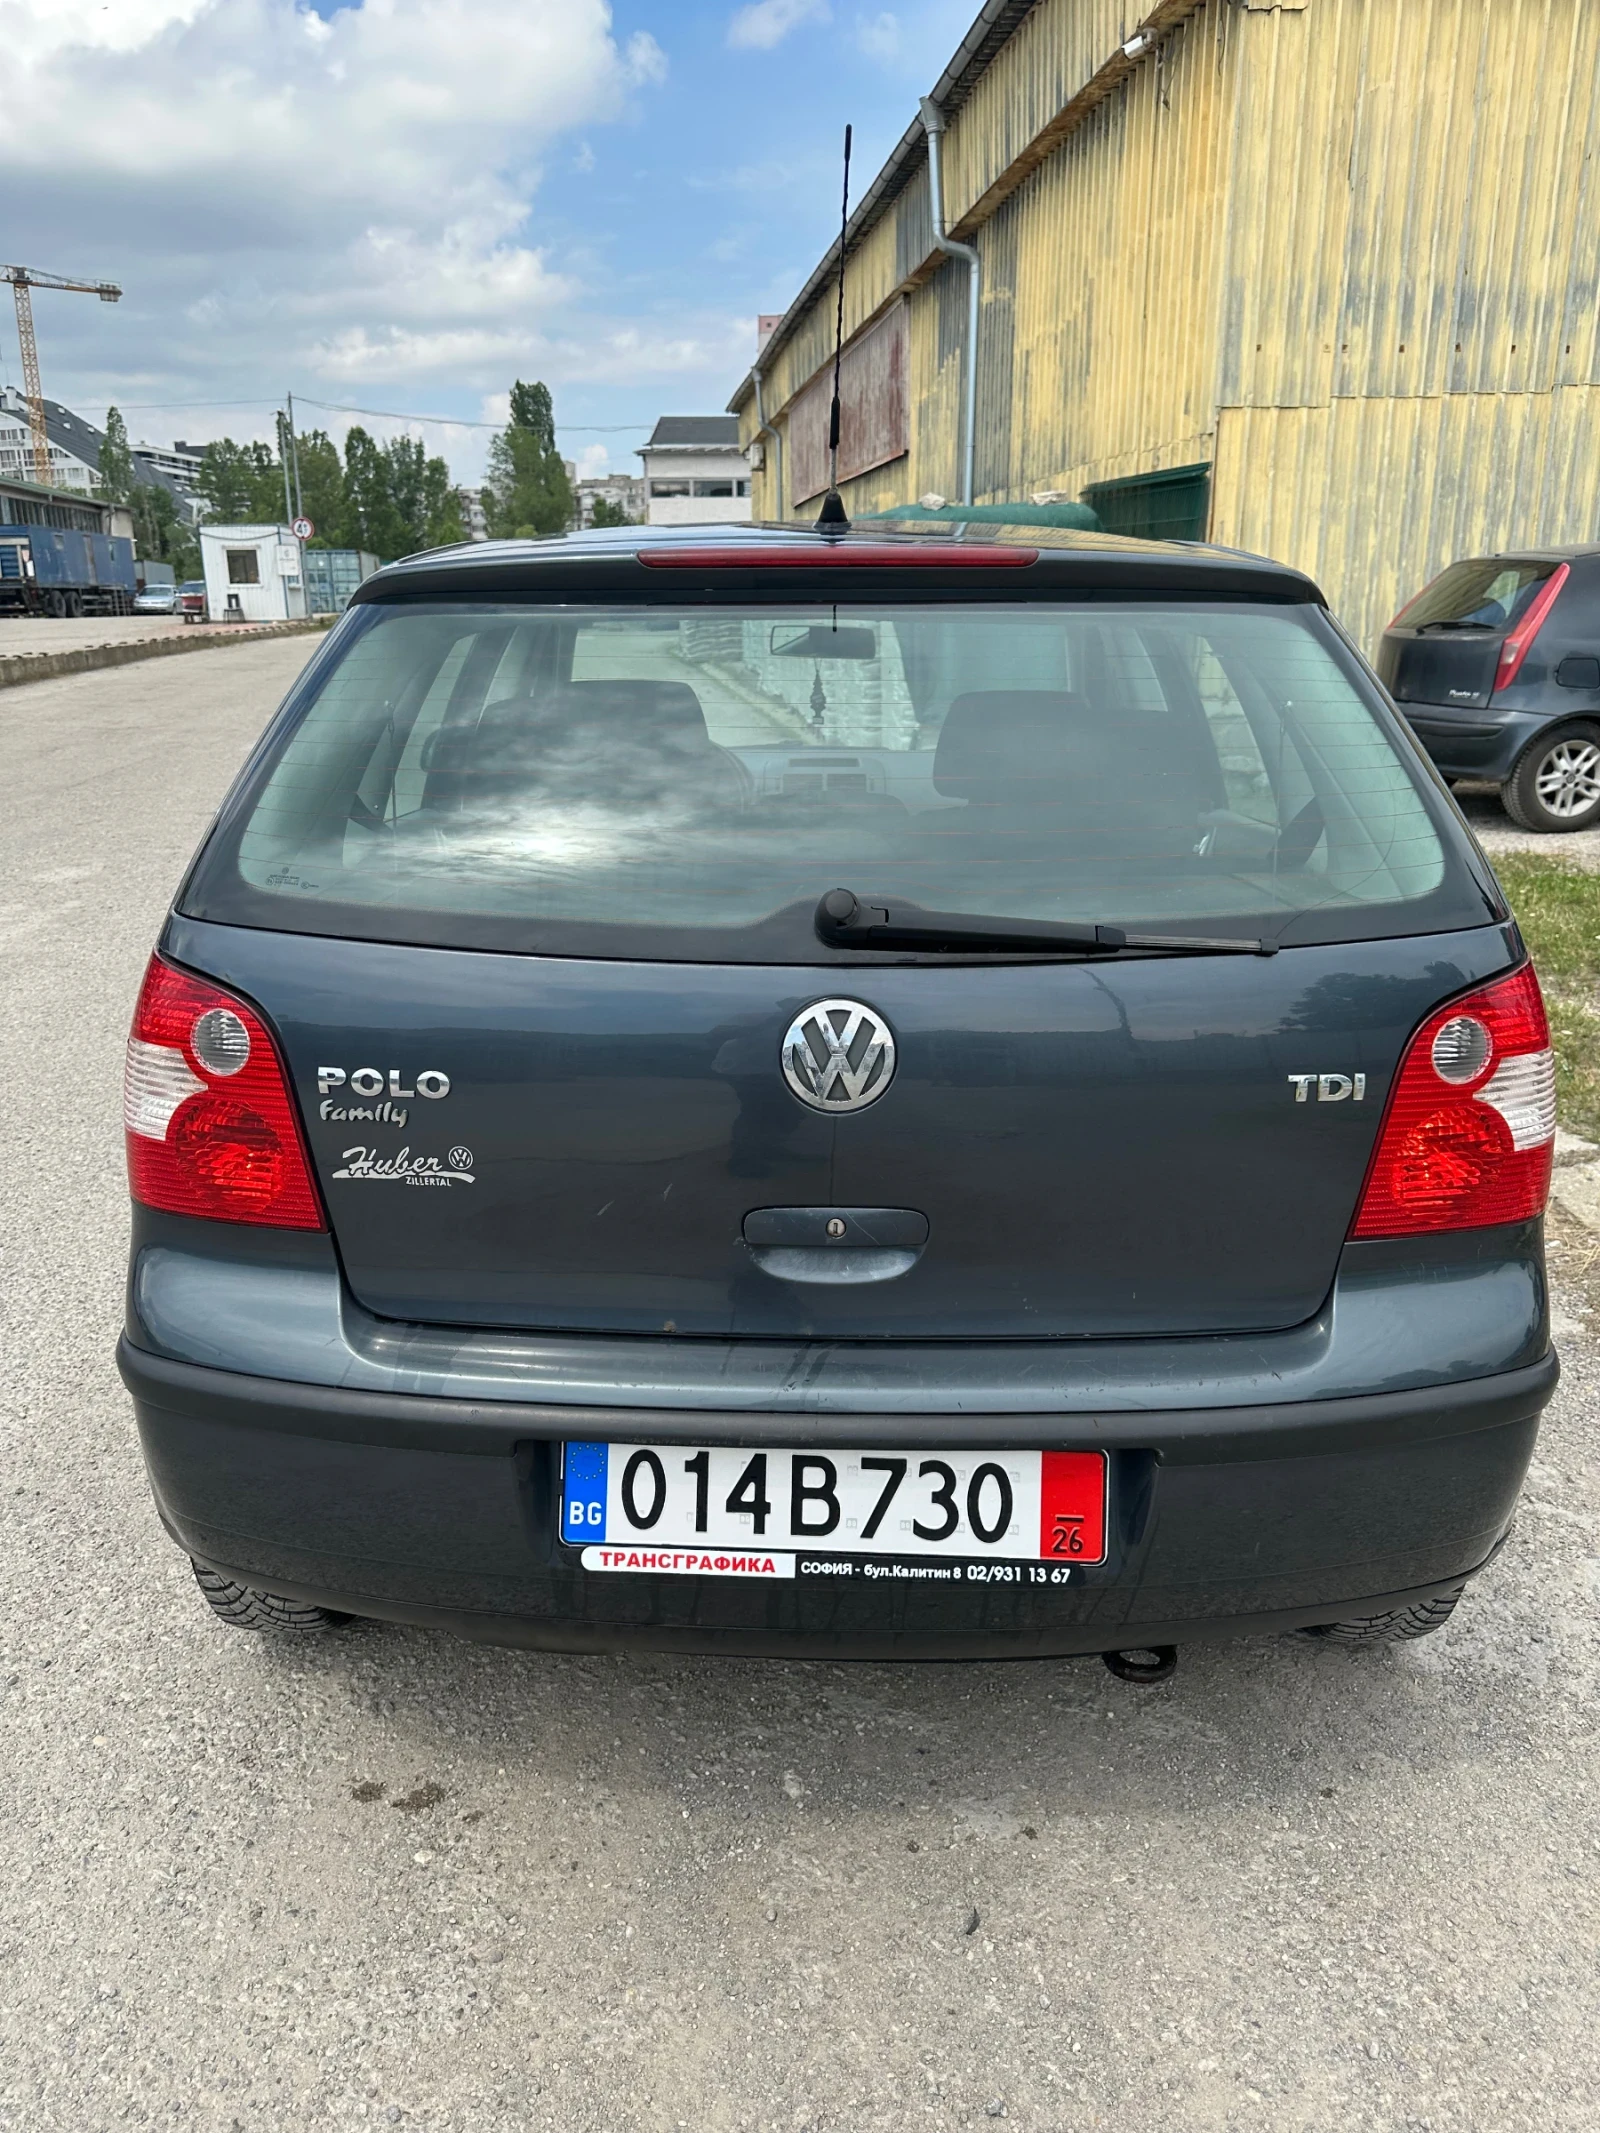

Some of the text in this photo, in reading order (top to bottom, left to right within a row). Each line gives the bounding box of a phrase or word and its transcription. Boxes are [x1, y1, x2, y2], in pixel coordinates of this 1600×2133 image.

[317, 1066, 450, 1099] POLO
[1286, 1073, 1366, 1102] TDI
[319, 1099, 408, 1128] Family
[342, 1145, 443, 1176] Huber
[405, 1175, 452, 1187] ZILLERTAL
[620, 1448, 1014, 1544] 014B730
[569, 1500, 602, 1526] BG
[1051, 1525, 1084, 1554] 26
[599, 1551, 776, 1574] ТРАНСГРАФИКА
[800, 1561, 852, 1576] СОФИЯ
[863, 1563, 951, 1581] бул.Калитин
[953, 1566, 962, 1579] 8
[966, 1564, 1022, 1583] 02/931
[1028, 1566, 1047, 1583] 13
[1050, 1567, 1071, 1584] 67
